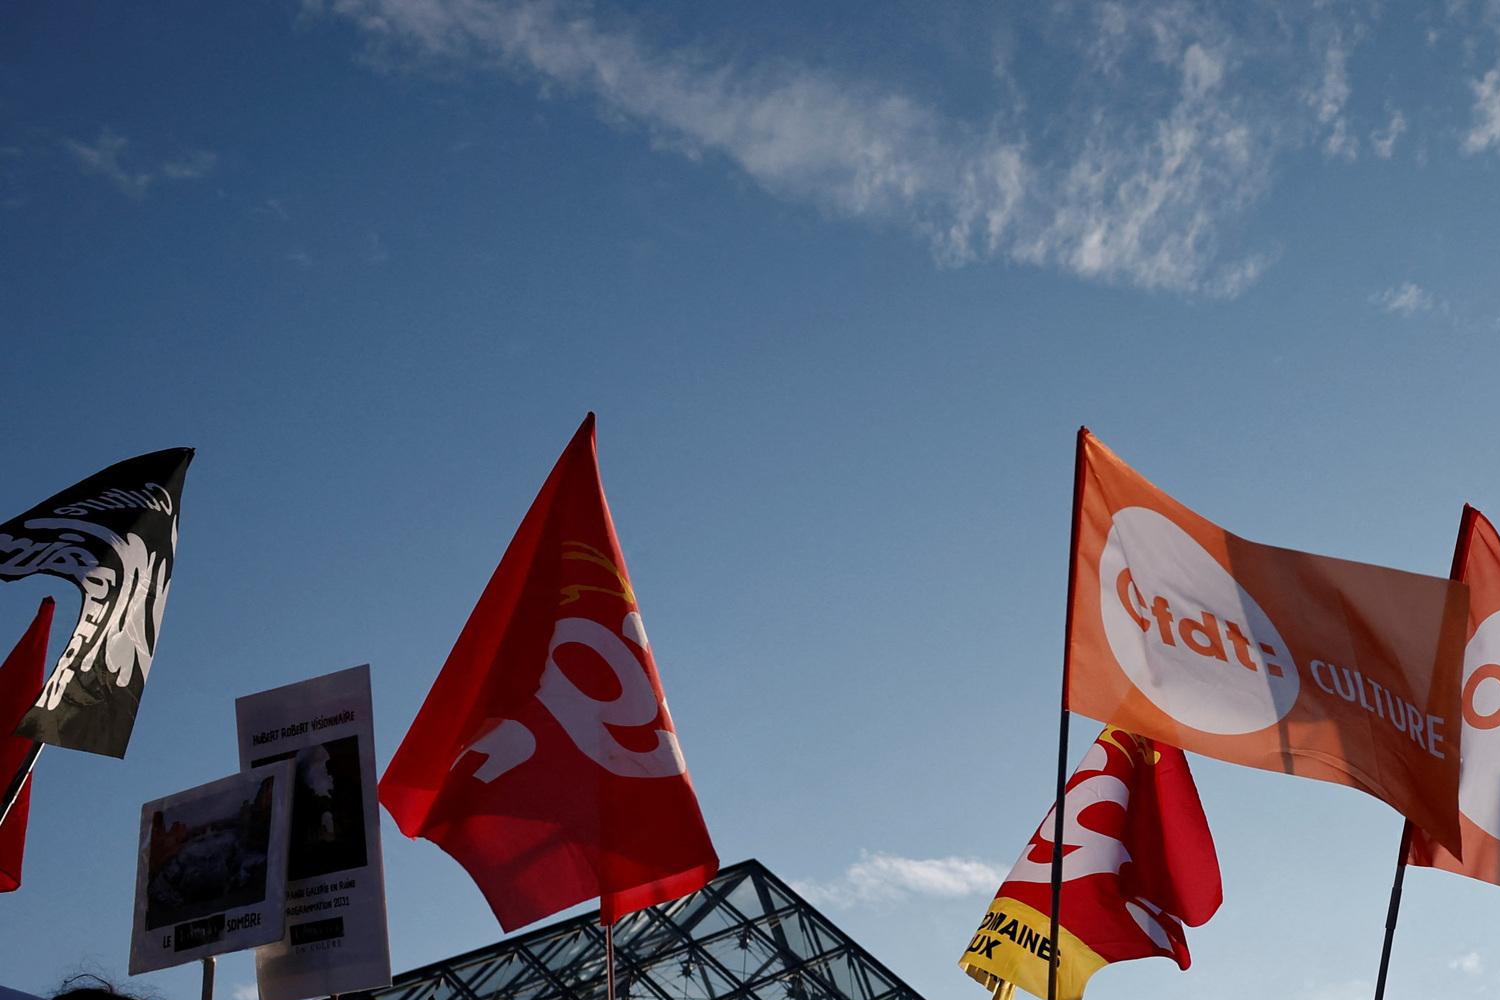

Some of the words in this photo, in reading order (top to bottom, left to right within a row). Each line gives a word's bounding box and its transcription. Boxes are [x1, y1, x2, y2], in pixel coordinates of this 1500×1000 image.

[1310, 659, 1446, 761] CULTURE
[252, 729, 279, 746] HUBERT
[281, 721, 309, 738] ROBERT
[163, 935, 172, 949] LE
[226, 913, 262, 933] SOMBRE
